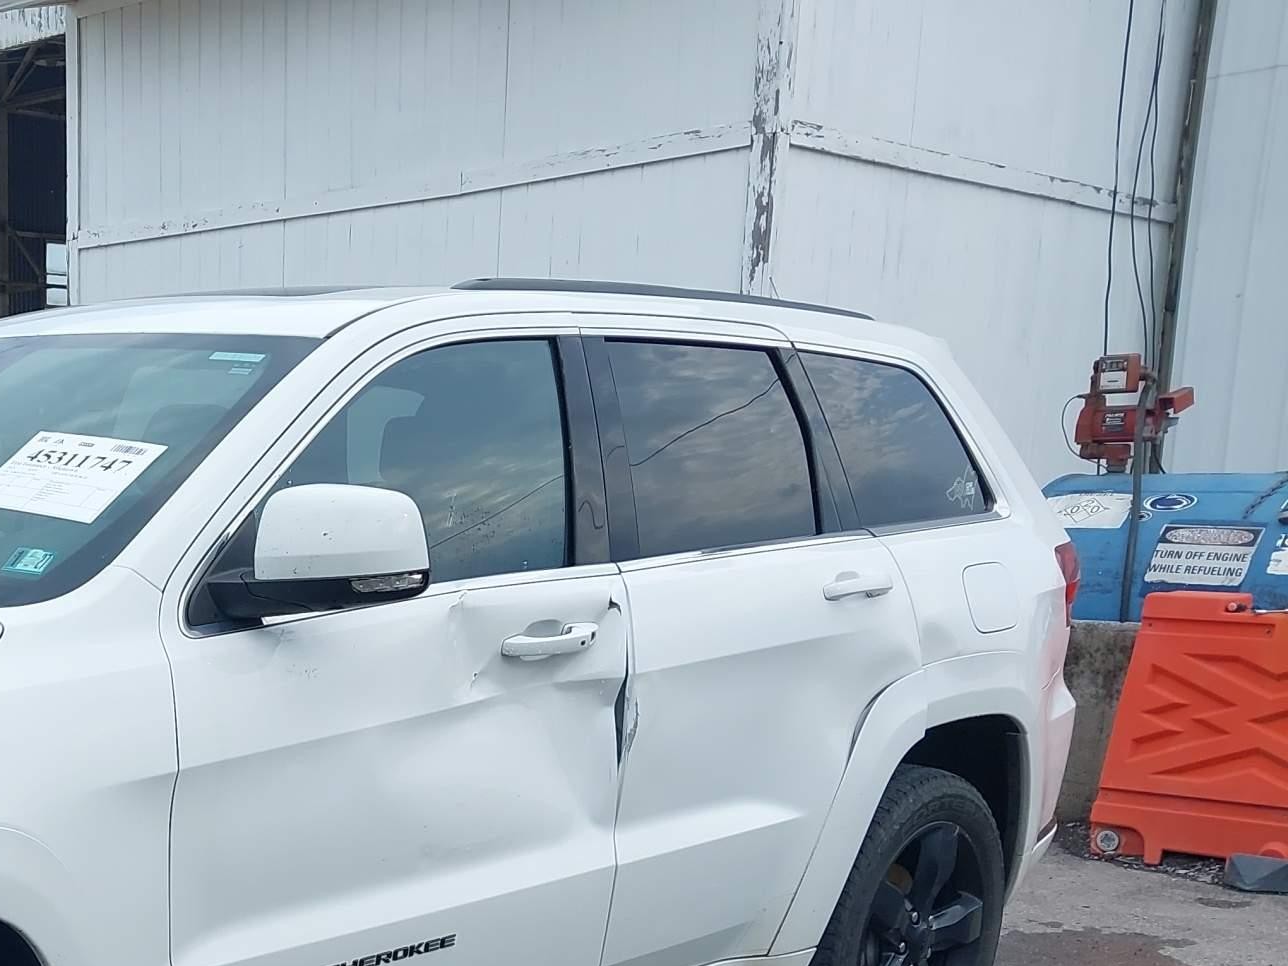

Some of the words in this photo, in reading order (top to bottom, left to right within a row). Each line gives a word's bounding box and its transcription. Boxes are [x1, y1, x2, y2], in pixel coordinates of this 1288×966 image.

[26, 448, 134, 474] 45311747
[1154, 549, 1183, 560] TURN
[1185, 550, 1206, 561] OFF
[1206, 552, 1249, 563] ENGINE
[1149, 563, 1183, 574] WHILE
[1183, 565, 1244, 578] REFUELING
